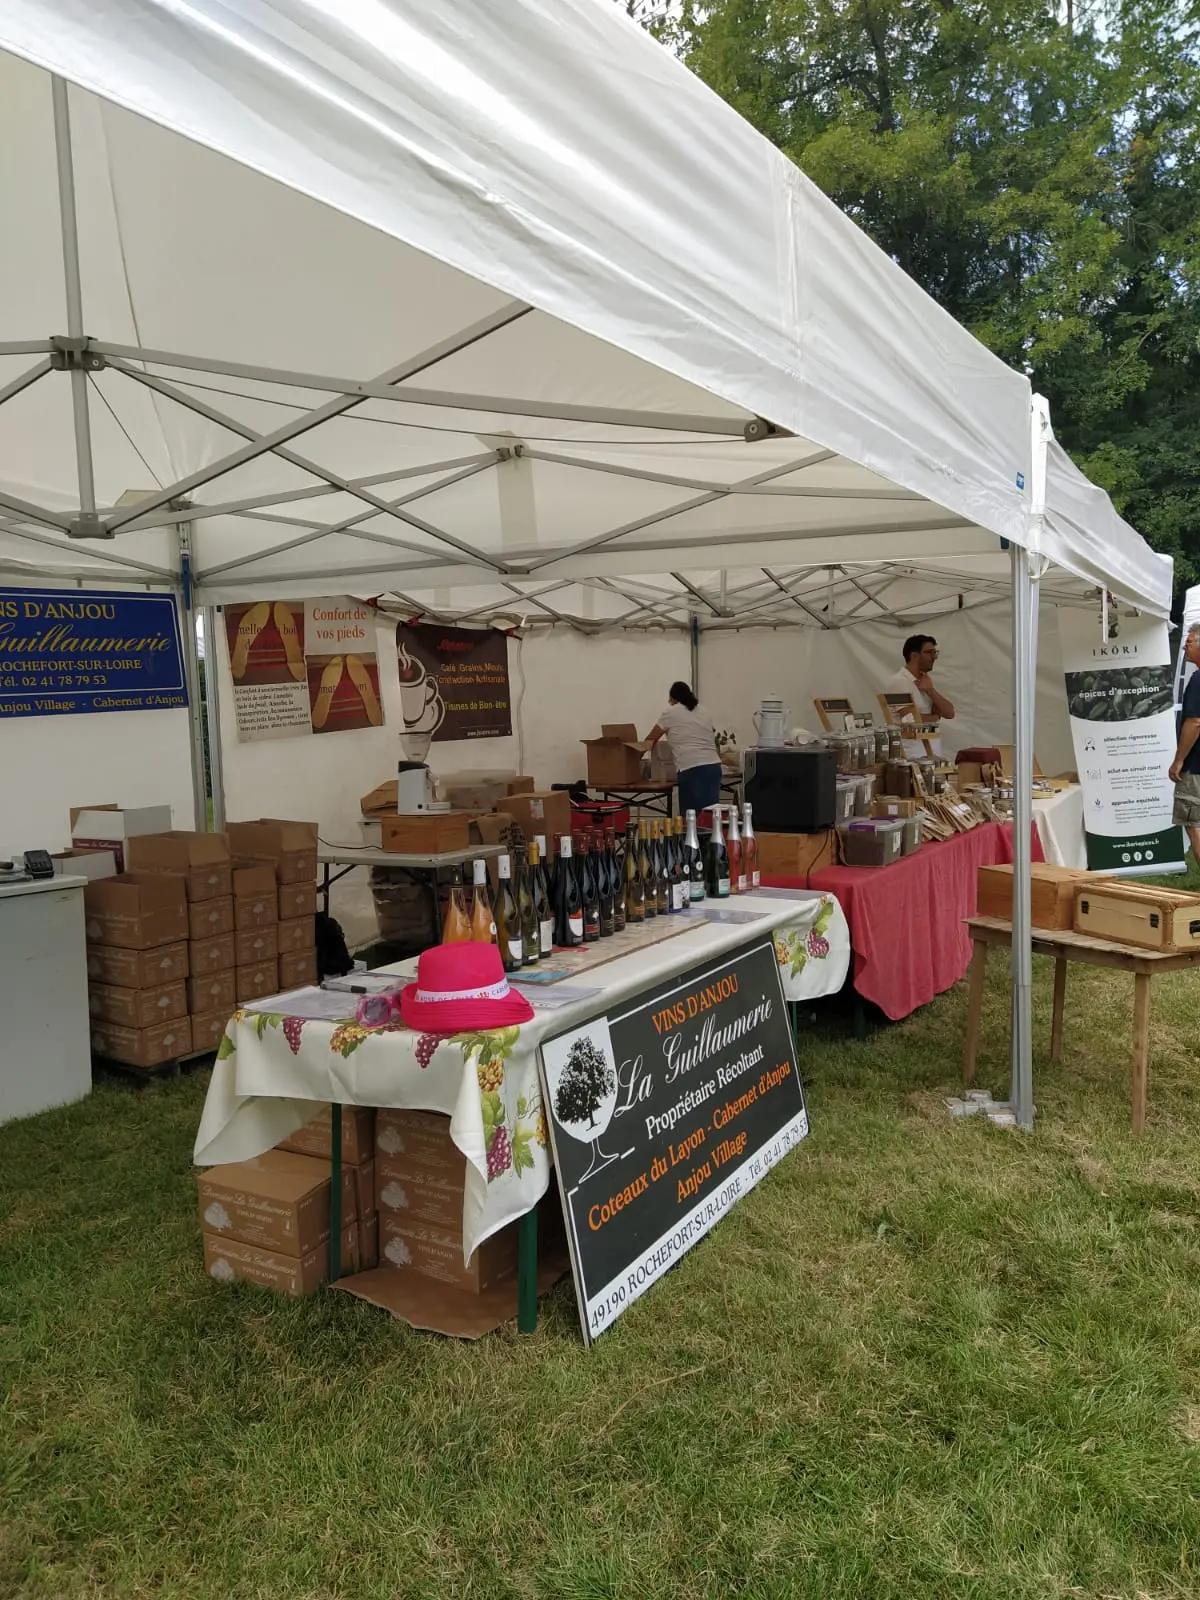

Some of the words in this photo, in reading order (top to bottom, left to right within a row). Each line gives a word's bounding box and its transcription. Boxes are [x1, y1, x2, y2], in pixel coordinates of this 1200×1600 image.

[24, 602, 116, 619] D'ANJOU
[313, 607, 351, 621] Confort
[354, 608, 367, 620] de
[317, 629, 334, 640] vos
[337, 625, 365, 642] pieds
[22, 676, 37, 687] 02
[40, 676, 54, 687] 41
[58, 675, 73, 686] 78
[76, 675, 90, 685] 79
[93, 675, 107, 685] 53
[1079, 688, 1107, 700] épices
[1109, 685, 1160, 695] d'exception
[0, 702, 31, 713] Anjou
[34, 700, 75, 712] Village
[93, 697, 142, 708] Cabernet
[146, 695, 184, 706] d'Anjou
[470, 701, 478, 710] de
[652, 1003, 686, 1036] VINS
[687, 973, 739, 1019] D'ANJOU
[614, 1054, 654, 1118] La
[662, 994, 773, 1084] Guillaumerie
[645, 1079, 716, 1140] Propriétaire
[716, 1044, 765, 1089] Récoltant
[588, 1173, 649, 1232] Coteaux
[651, 1157, 668, 1183] du
[668, 1127, 706, 1166] Layon
[712, 1085, 758, 1130] Cabernet
[758, 1061, 791, 1097] d'Anjou
[676, 1160, 712, 1203] Anjou
[711, 1130, 748, 1169] Village
[590, 1285, 627, 1331] 49190
[627, 1176, 743, 1294] ROCHEFORT-SUR-LOIRE
[748, 1161, 764, 1181] Tél.
[763, 1153, 774, 1168] 02
[773, 1145, 783, 1160] 41
[781, 1133, 792, 1150] 78
[790, 1125, 800, 1142] 79
[799, 1116, 809, 1133] 53
